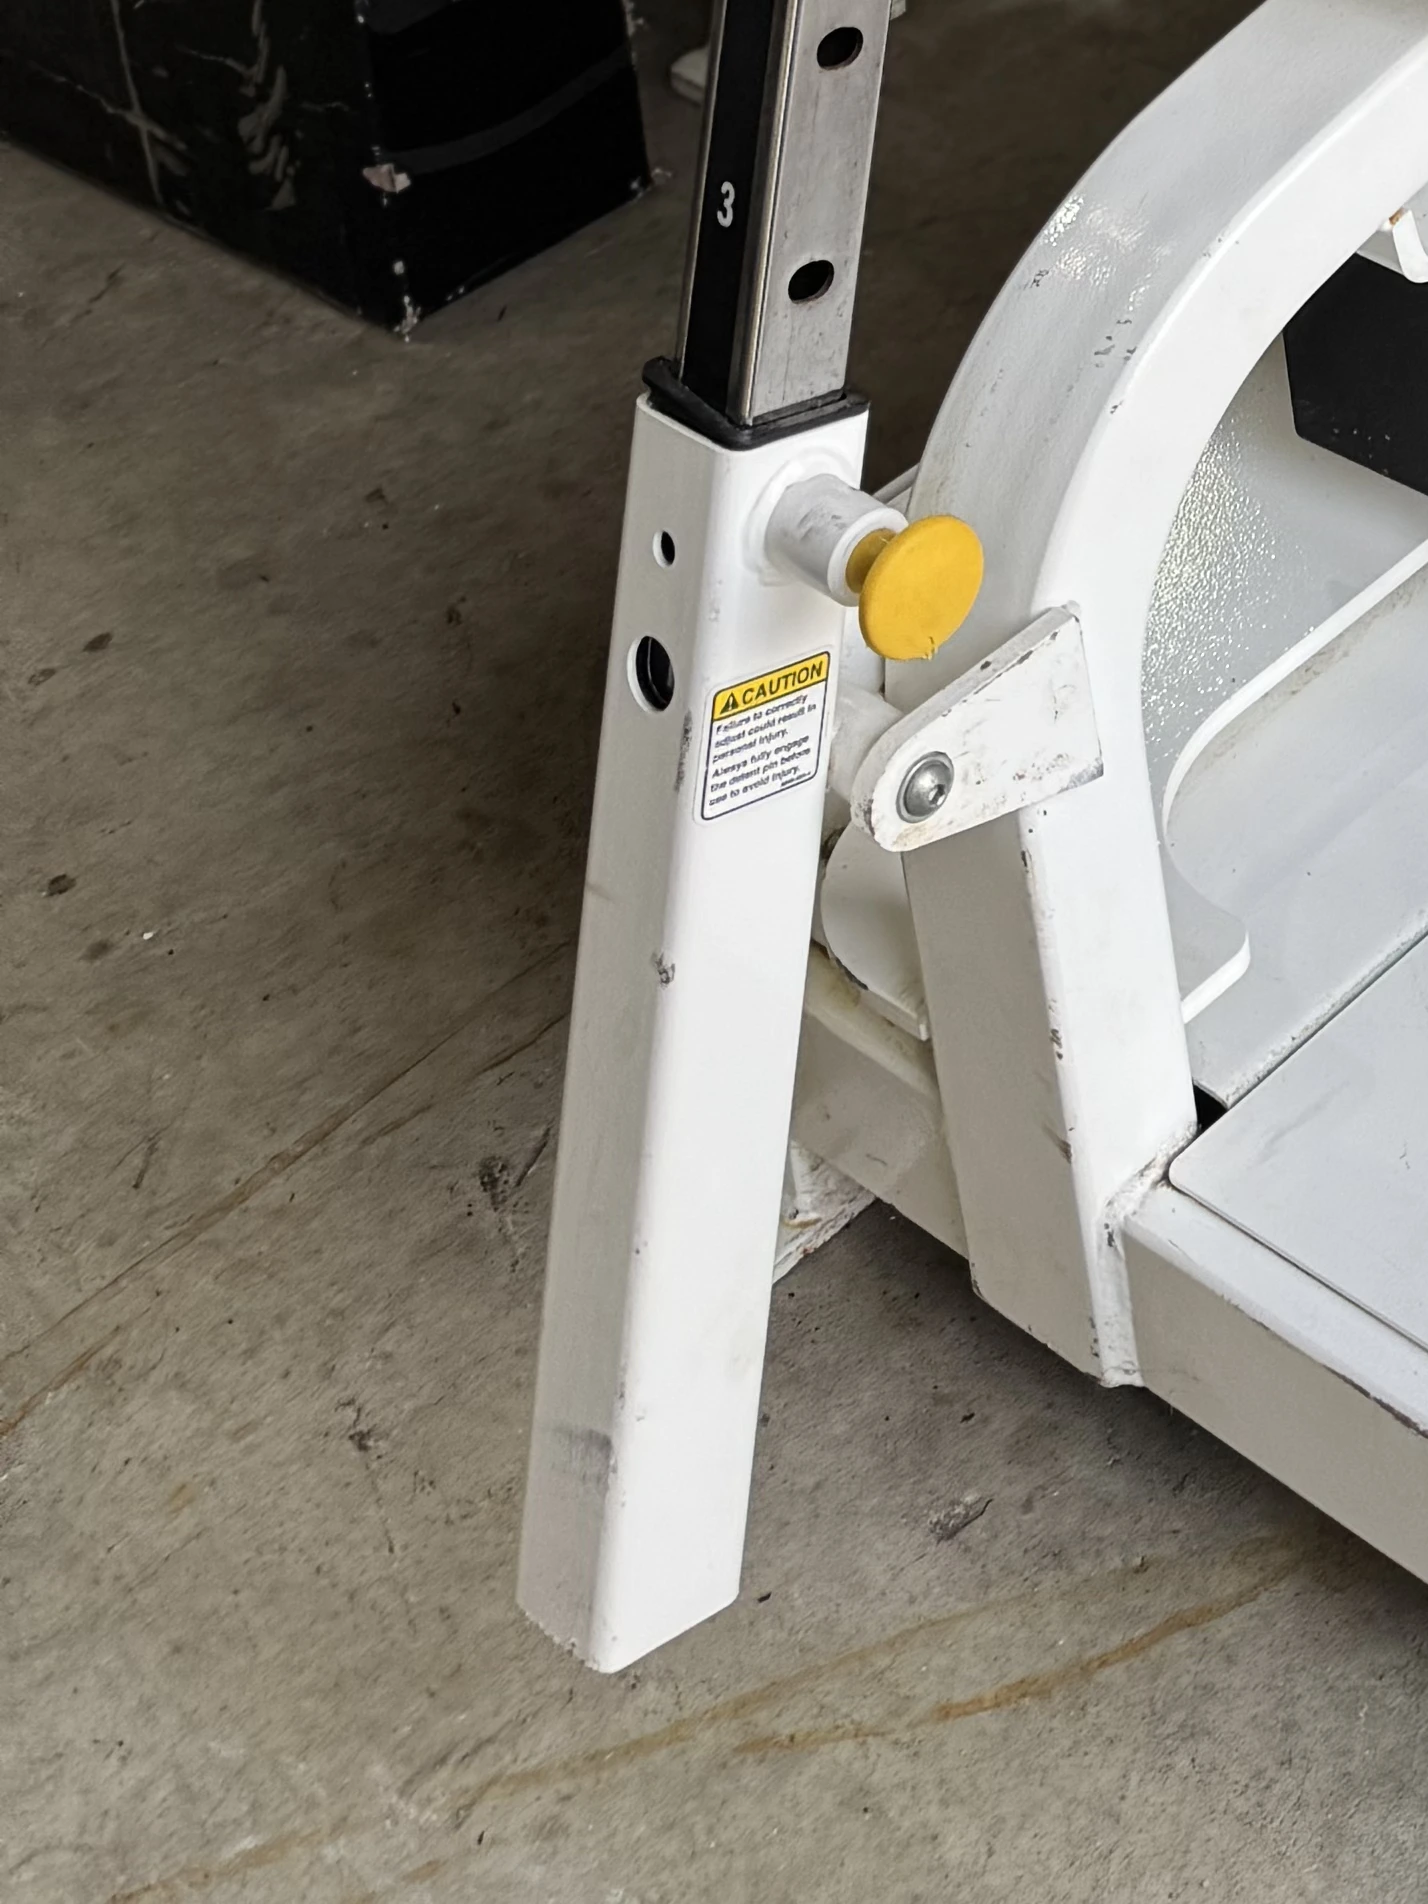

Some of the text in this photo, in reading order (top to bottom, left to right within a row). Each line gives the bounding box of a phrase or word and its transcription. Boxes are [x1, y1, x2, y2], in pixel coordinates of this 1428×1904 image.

[716, 180, 736, 229] 3
[742, 660, 823, 705] CAUTION
[715, 704, 816, 748] adjust could result in
[716, 694, 808, 734] Failure to correctly
[712, 729, 789, 764] personal injury.
[712, 734, 810, 779] Always fully engage
[710, 746, 811, 793] the detent pin before
[730, 788, 740, 798] to
[742, 776, 770, 794] avoid
[771, 766, 800, 783] injury.
